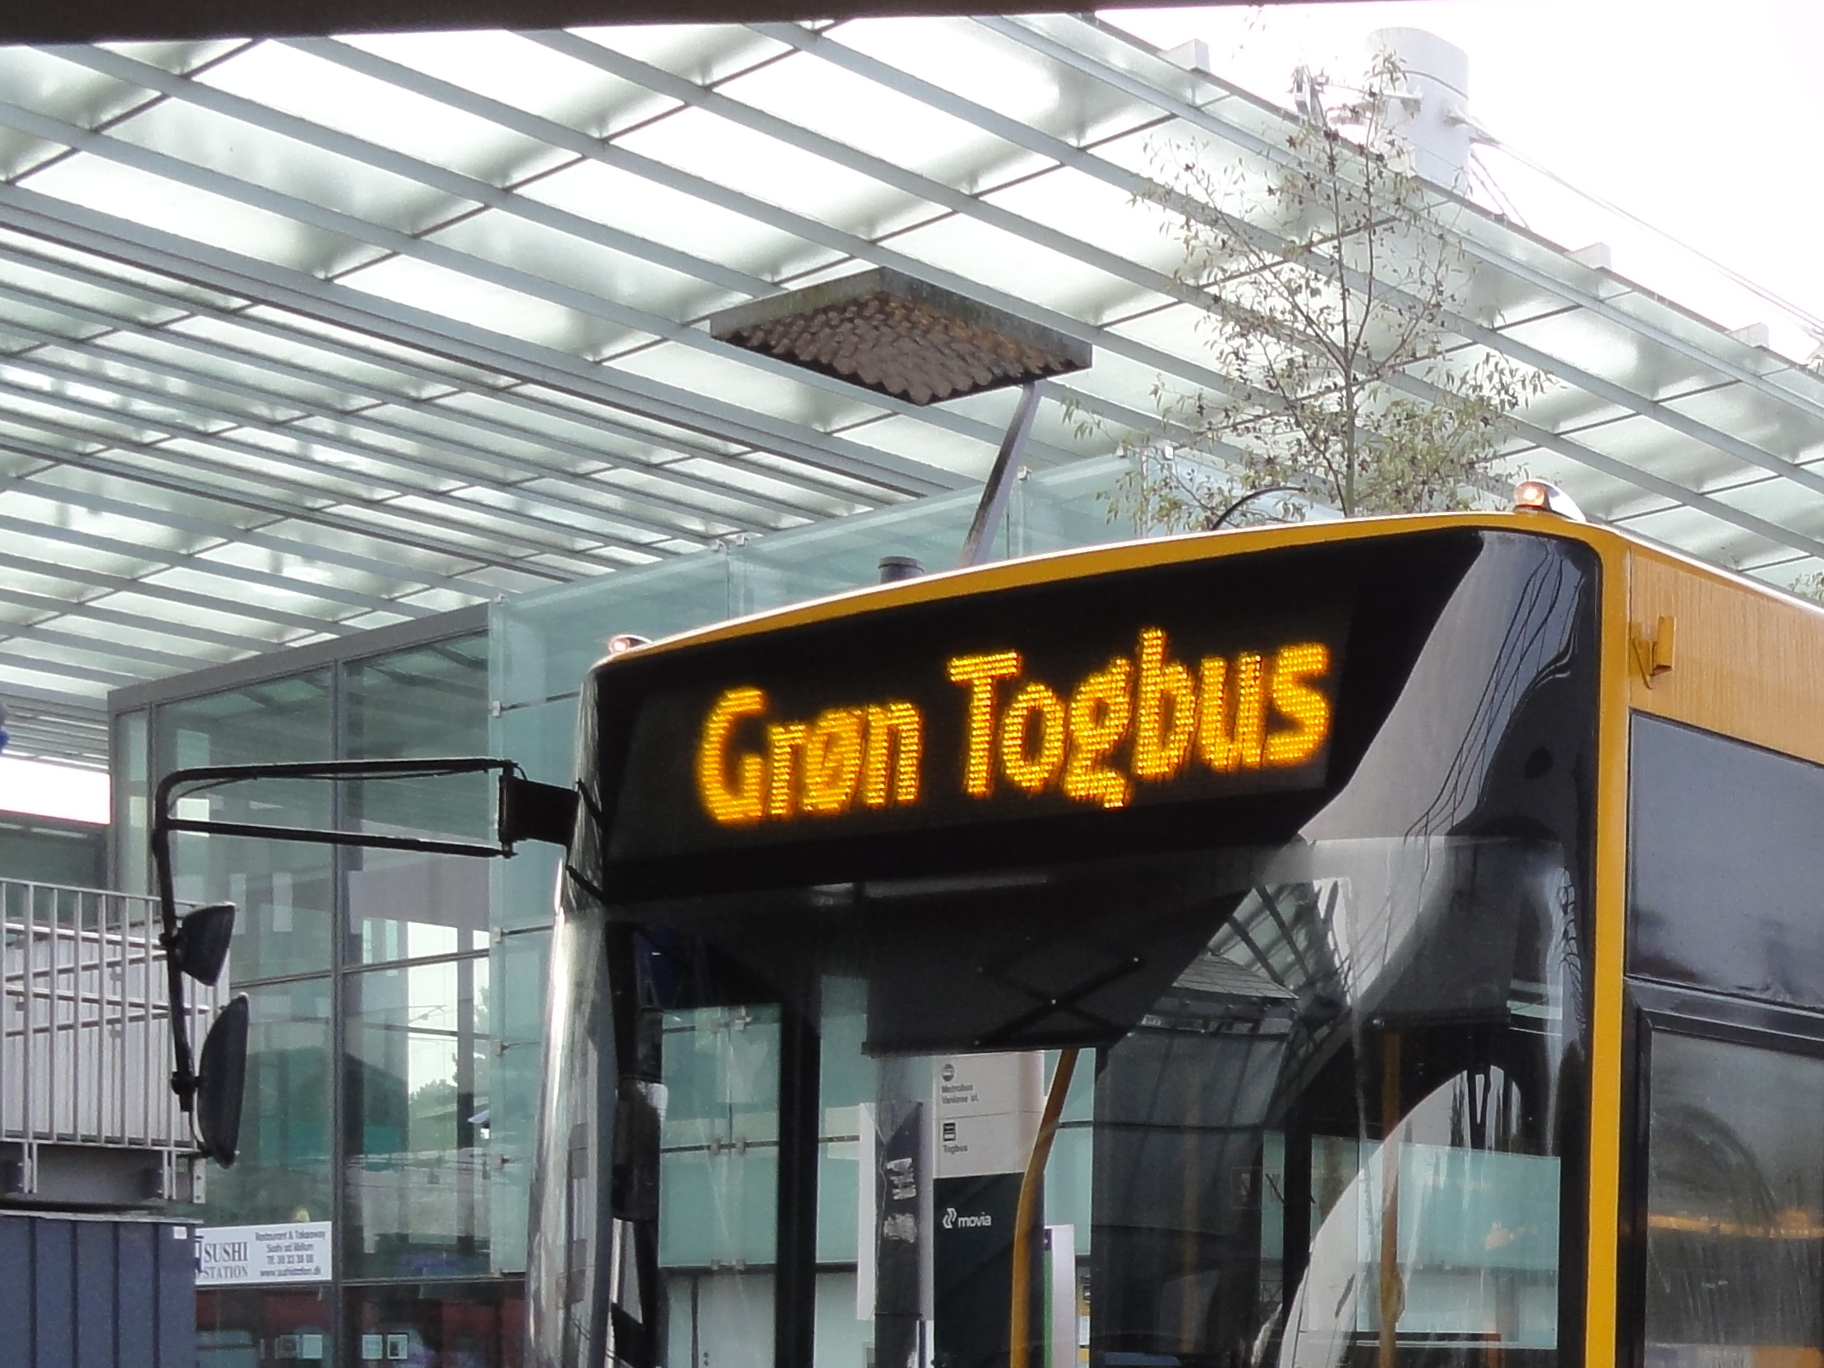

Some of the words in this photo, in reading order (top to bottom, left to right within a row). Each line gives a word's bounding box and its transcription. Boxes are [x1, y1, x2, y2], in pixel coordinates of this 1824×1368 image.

[700, 686, 923, 825] Grøn
[947, 627, 1331, 809] Togbus
[943, 1144, 968, 1155] Togbus
[957, 1211, 992, 1228] movia
[203, 1241, 249, 1264] SUSHI
[203, 1265, 249, 1279] STATION
